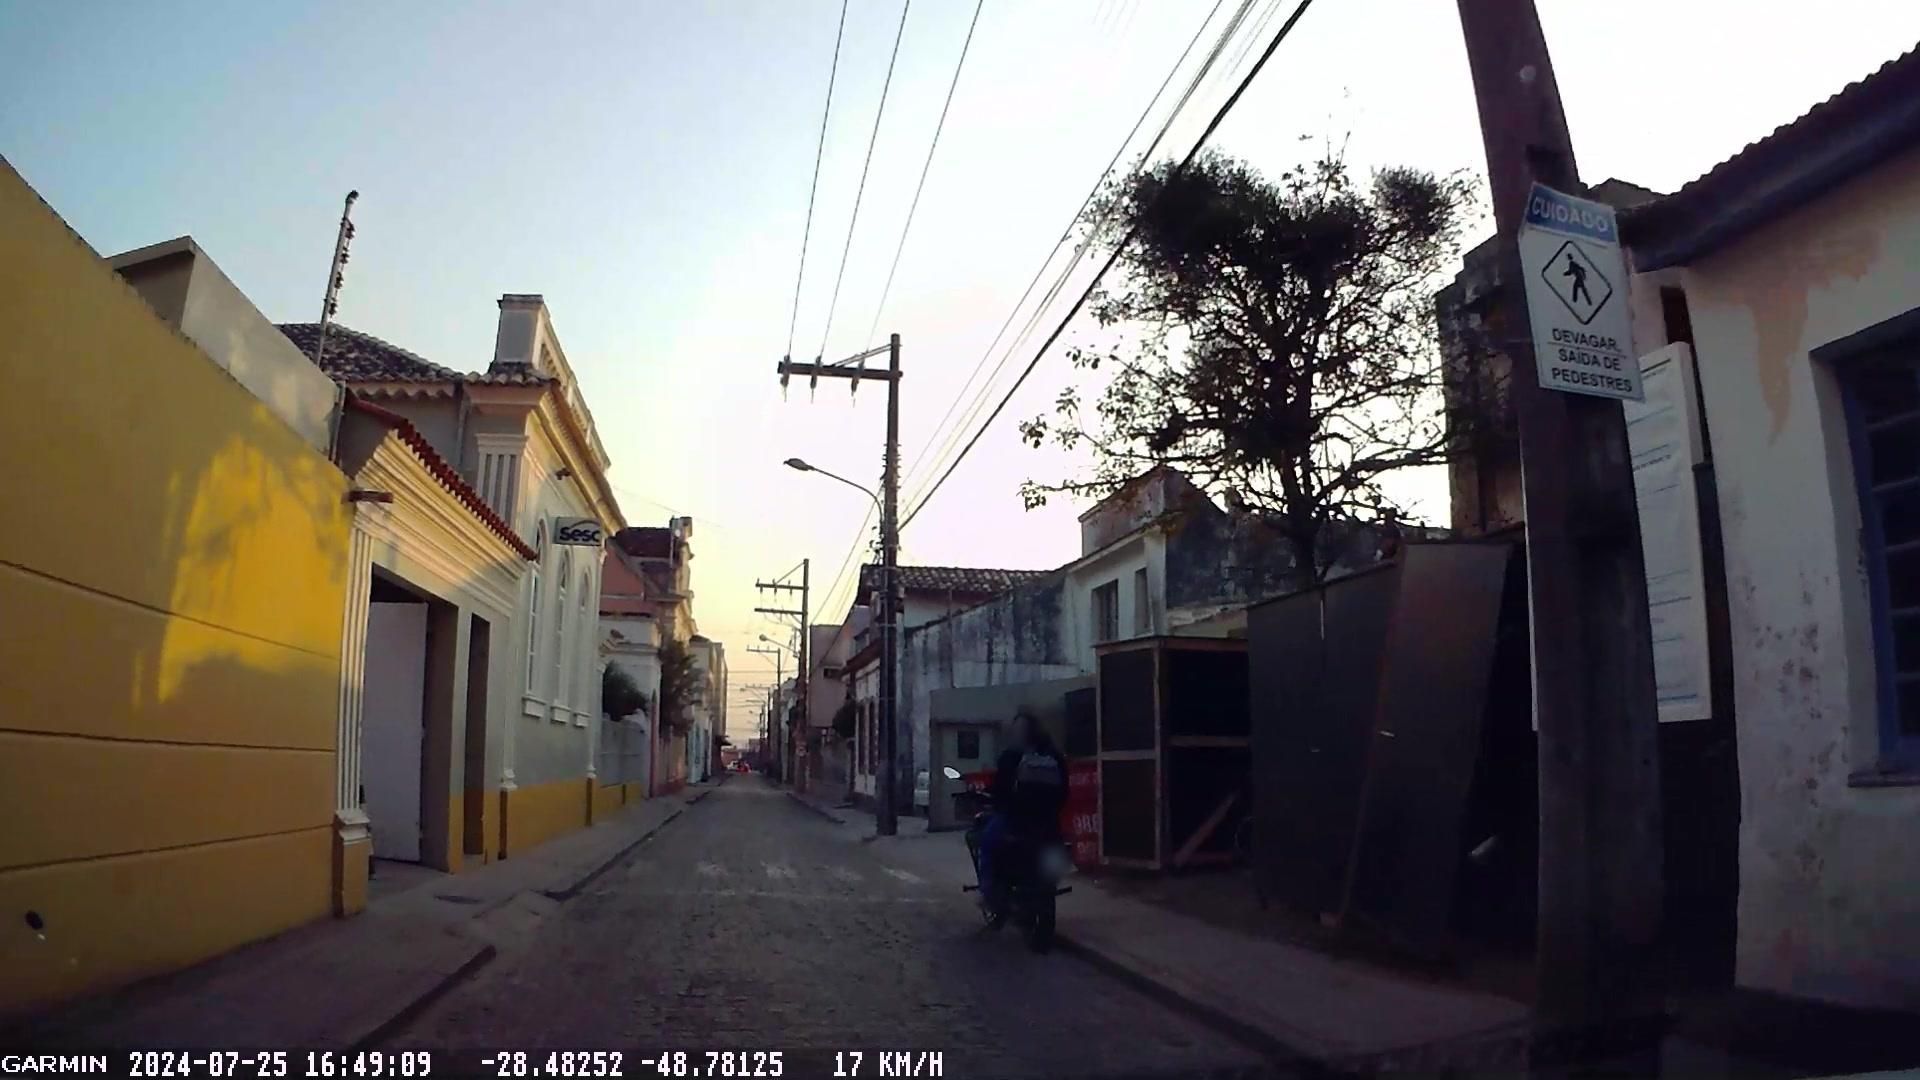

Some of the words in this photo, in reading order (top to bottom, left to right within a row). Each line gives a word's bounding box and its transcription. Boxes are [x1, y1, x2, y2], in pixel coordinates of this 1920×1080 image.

[1532, 196, 1609, 232] CUIDADO
[1603, 356, 1622, 371] DE
[1551, 367, 1632, 392] PEDESTRES
